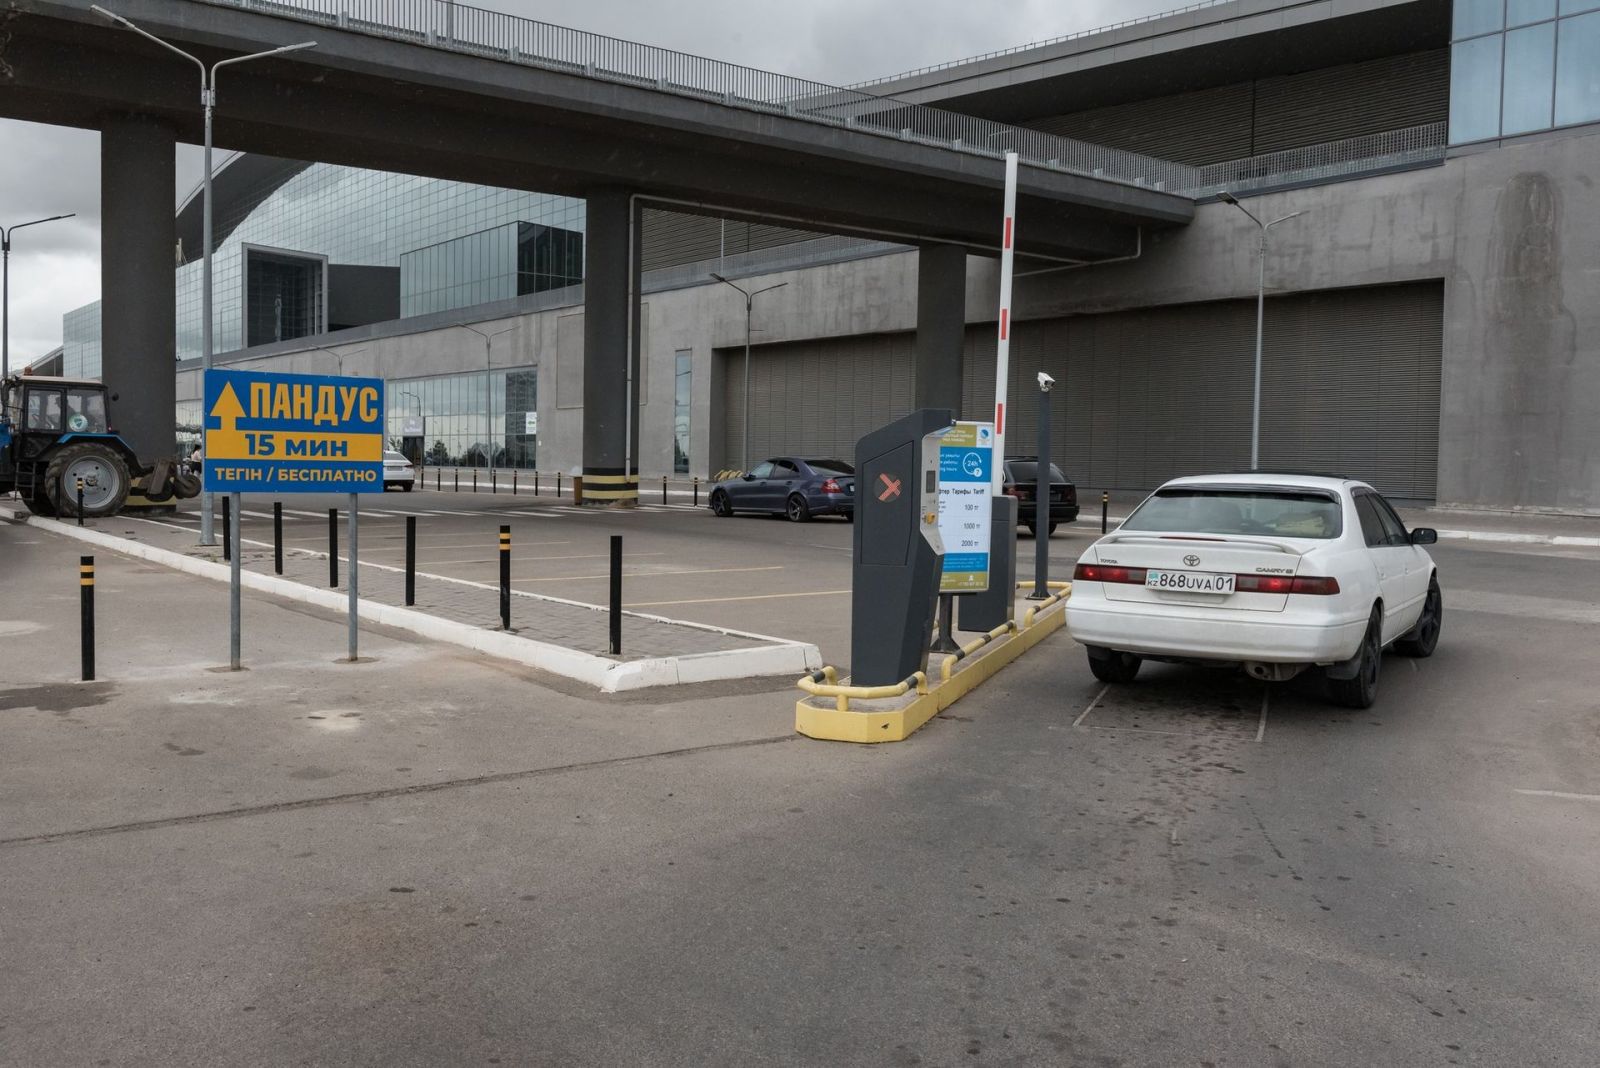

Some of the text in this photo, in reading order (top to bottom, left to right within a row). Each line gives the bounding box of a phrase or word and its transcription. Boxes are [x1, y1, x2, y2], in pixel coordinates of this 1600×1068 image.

[250, 382, 378, 426] ПАНДУС
[245, 433, 275, 456] 15
[215, 468, 262, 481] ТЕГІН
[278, 469, 377, 482] БЕСПЛАТНО
